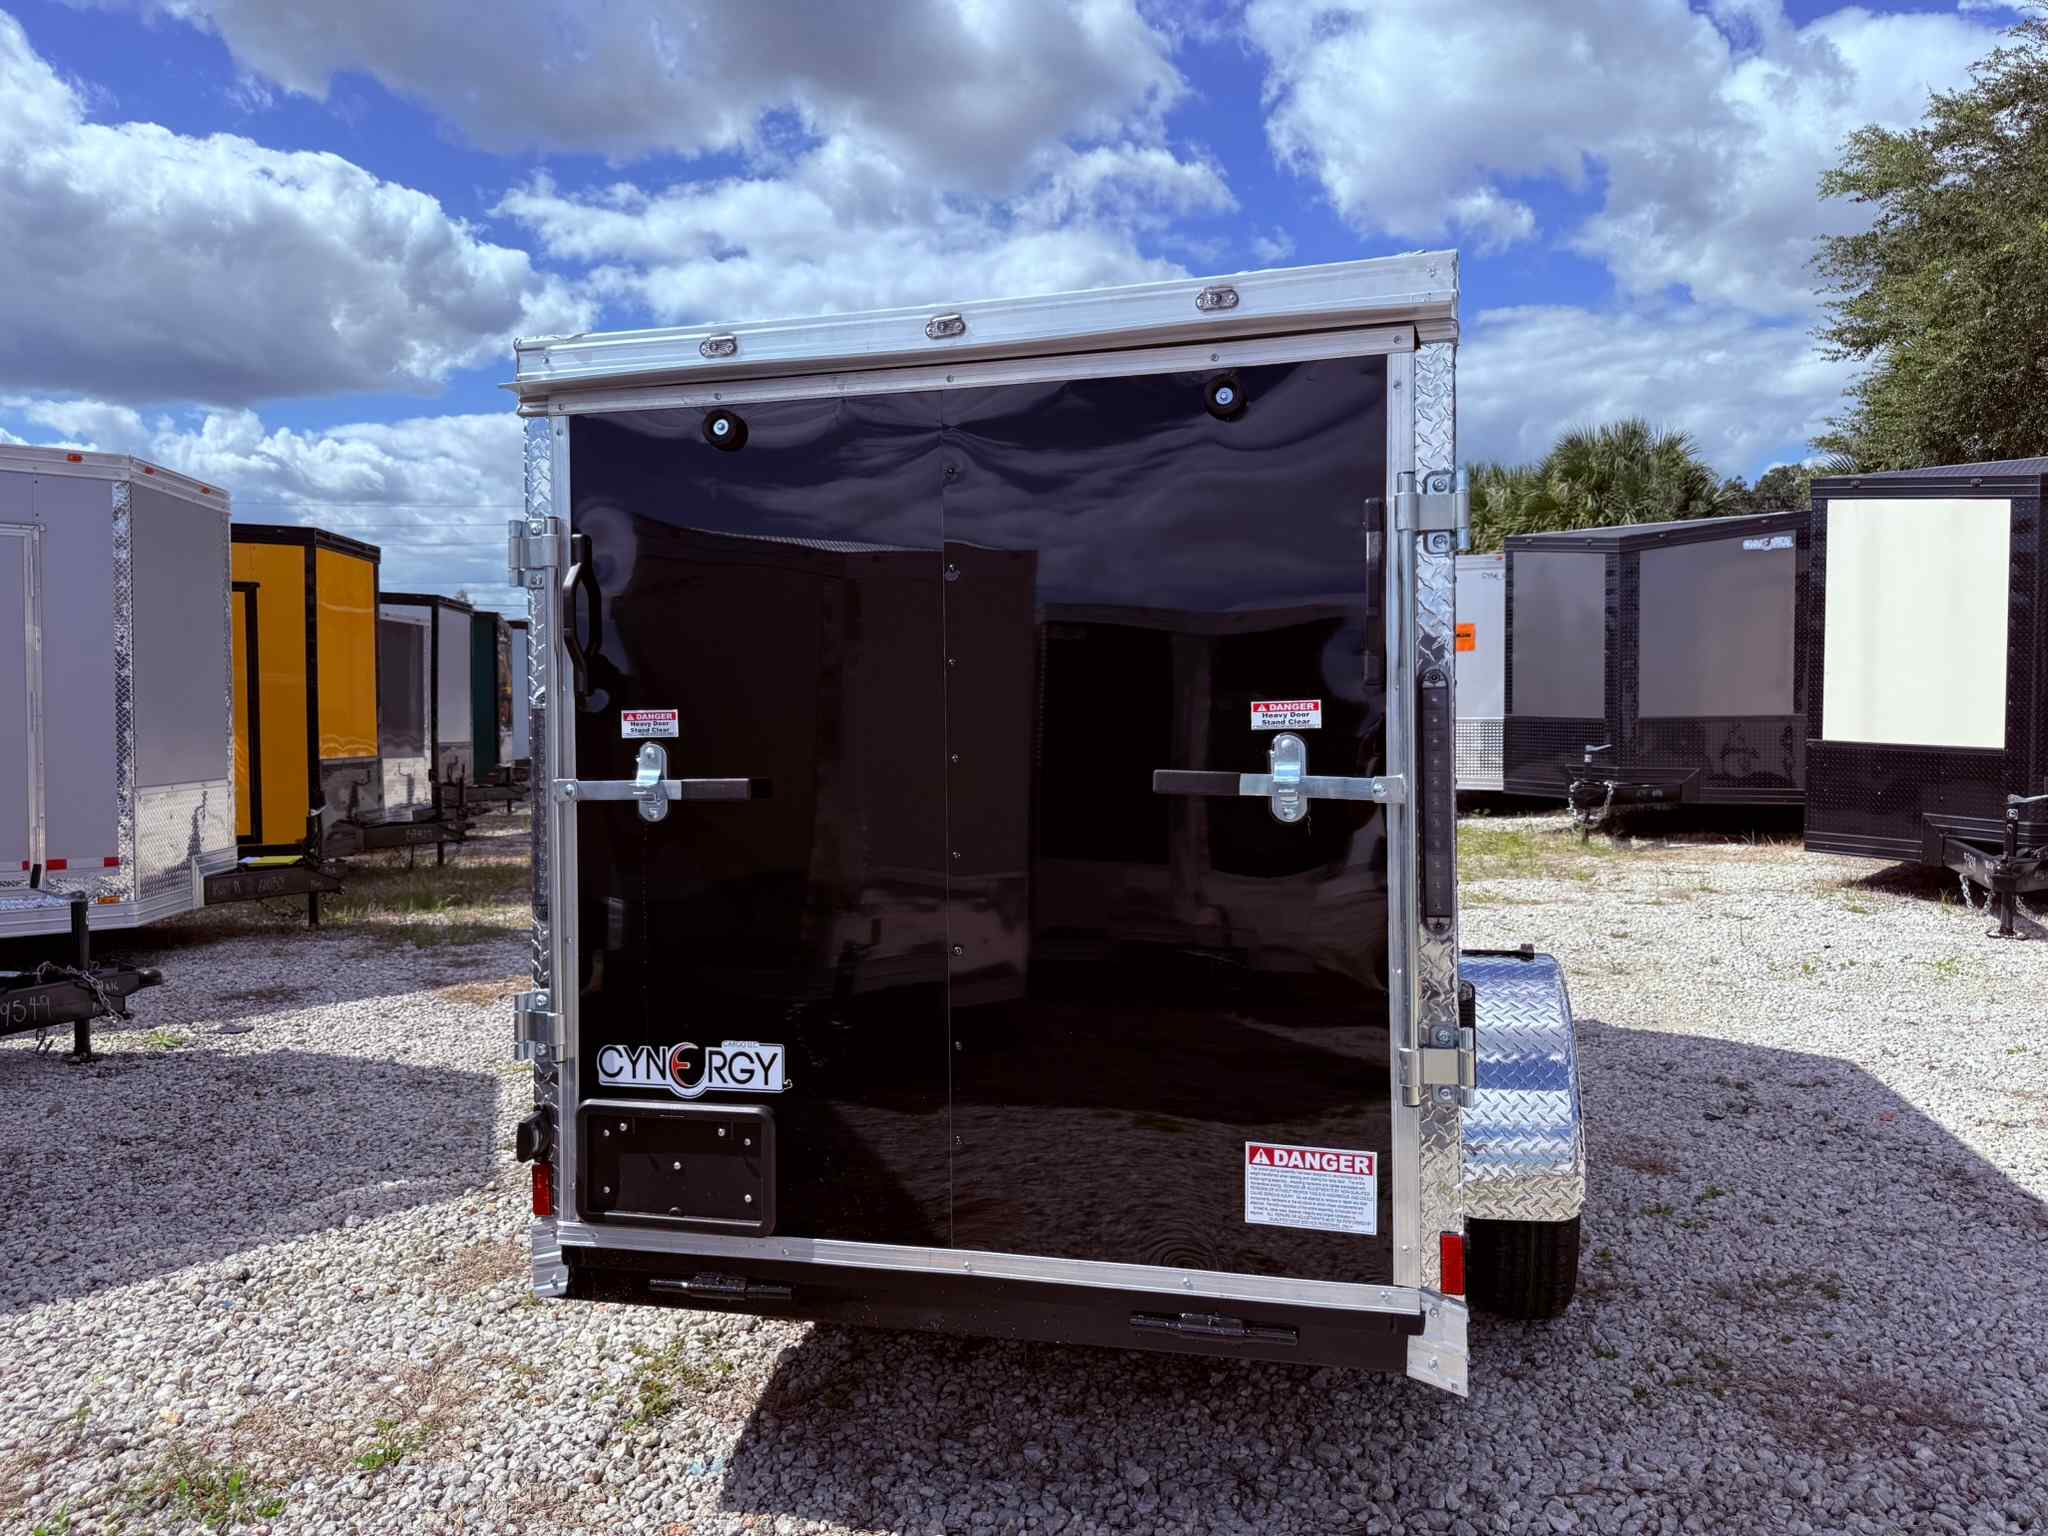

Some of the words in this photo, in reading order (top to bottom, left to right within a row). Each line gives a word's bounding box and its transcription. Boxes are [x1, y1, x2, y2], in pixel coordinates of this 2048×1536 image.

[1269, 702, 1314, 711] DANGER
[599, 1042, 778, 1088] CYNERGY
[1273, 1149, 1370, 1174] DANGER
